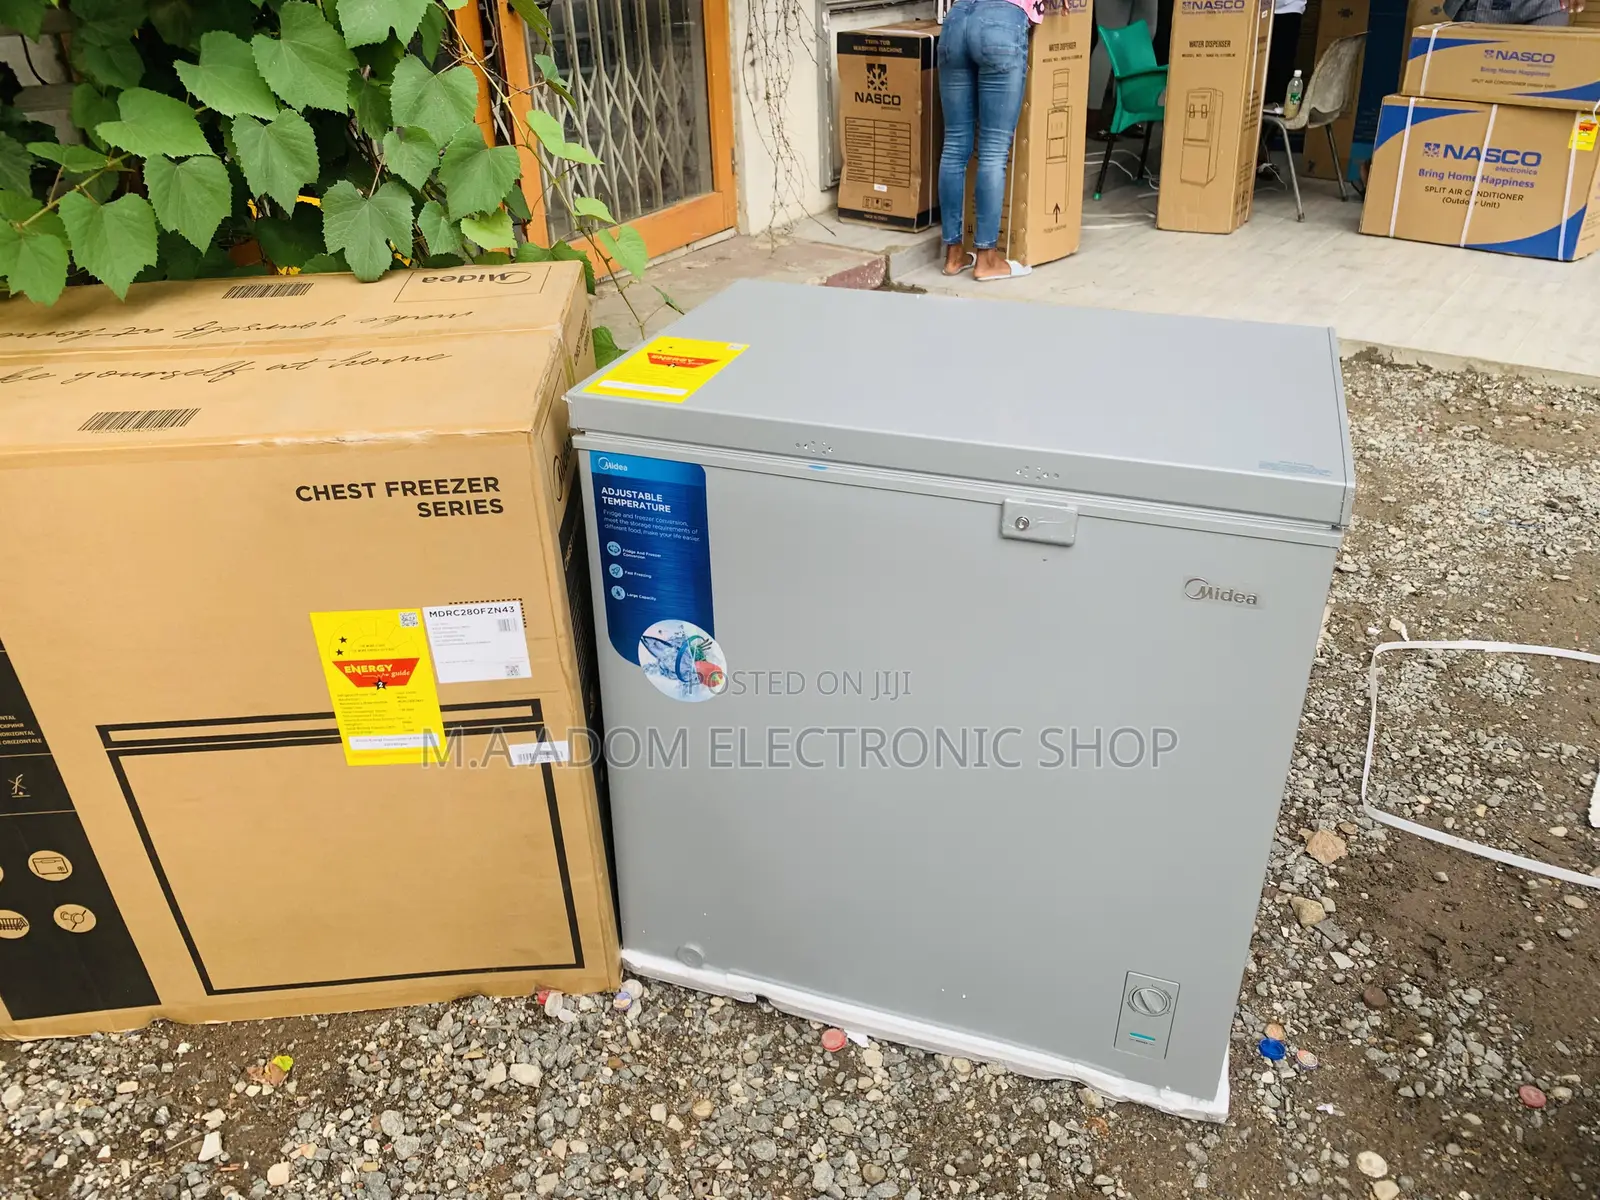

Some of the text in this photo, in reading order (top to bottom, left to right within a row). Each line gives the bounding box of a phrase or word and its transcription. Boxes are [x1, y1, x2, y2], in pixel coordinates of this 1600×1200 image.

[1192, 1, 1245, 10] NASCO
[1495, 50, 1556, 64] NASCO
[854, 91, 901, 106] NASCO
[1443, 144, 1542, 167] NASCO
[1418, 168, 1445, 181] Bring
[1479, 175, 1535, 189] Happiness
[1494, 165, 1538, 176] electronics
[1424, 185, 1525, 201] SPLIT AIR CNDITIONER
[1441, 196, 1501, 209] (Outdor Unit)
[421, 271, 532, 285] Midea
[60, 360, 255, 385] yourself
[265, 357, 336, 371] at
[327, 350, 453, 369] home
[597, 456, 628, 472] Midea
[295, 476, 501, 502] CHEST FREEZER
[601, 486, 663, 503] ADJUSTABLE
[416, 498, 504, 518] SERIES
[601, 496, 672, 513] TEMPERATURE
[603, 509, 621, 518] Fridge
[622, 511, 634, 519] and
[634, 513, 655, 522] freezer
[603, 516, 619, 524] meet
[619, 518, 629, 526] the
[629, 520, 652, 530] storage
[652, 523, 690, 534] requirements
[604, 523, 627, 532] different
[642, 529, 659, 537] make
[659, 532, 673, 540] your
[672, 532, 682, 540] life
[1183, 576, 1260, 606] Midea
[429, 605, 515, 618] MDRC280FZN43
[343, 663, 393, 676] ENERGY
[390, 668, 411, 679] guide
